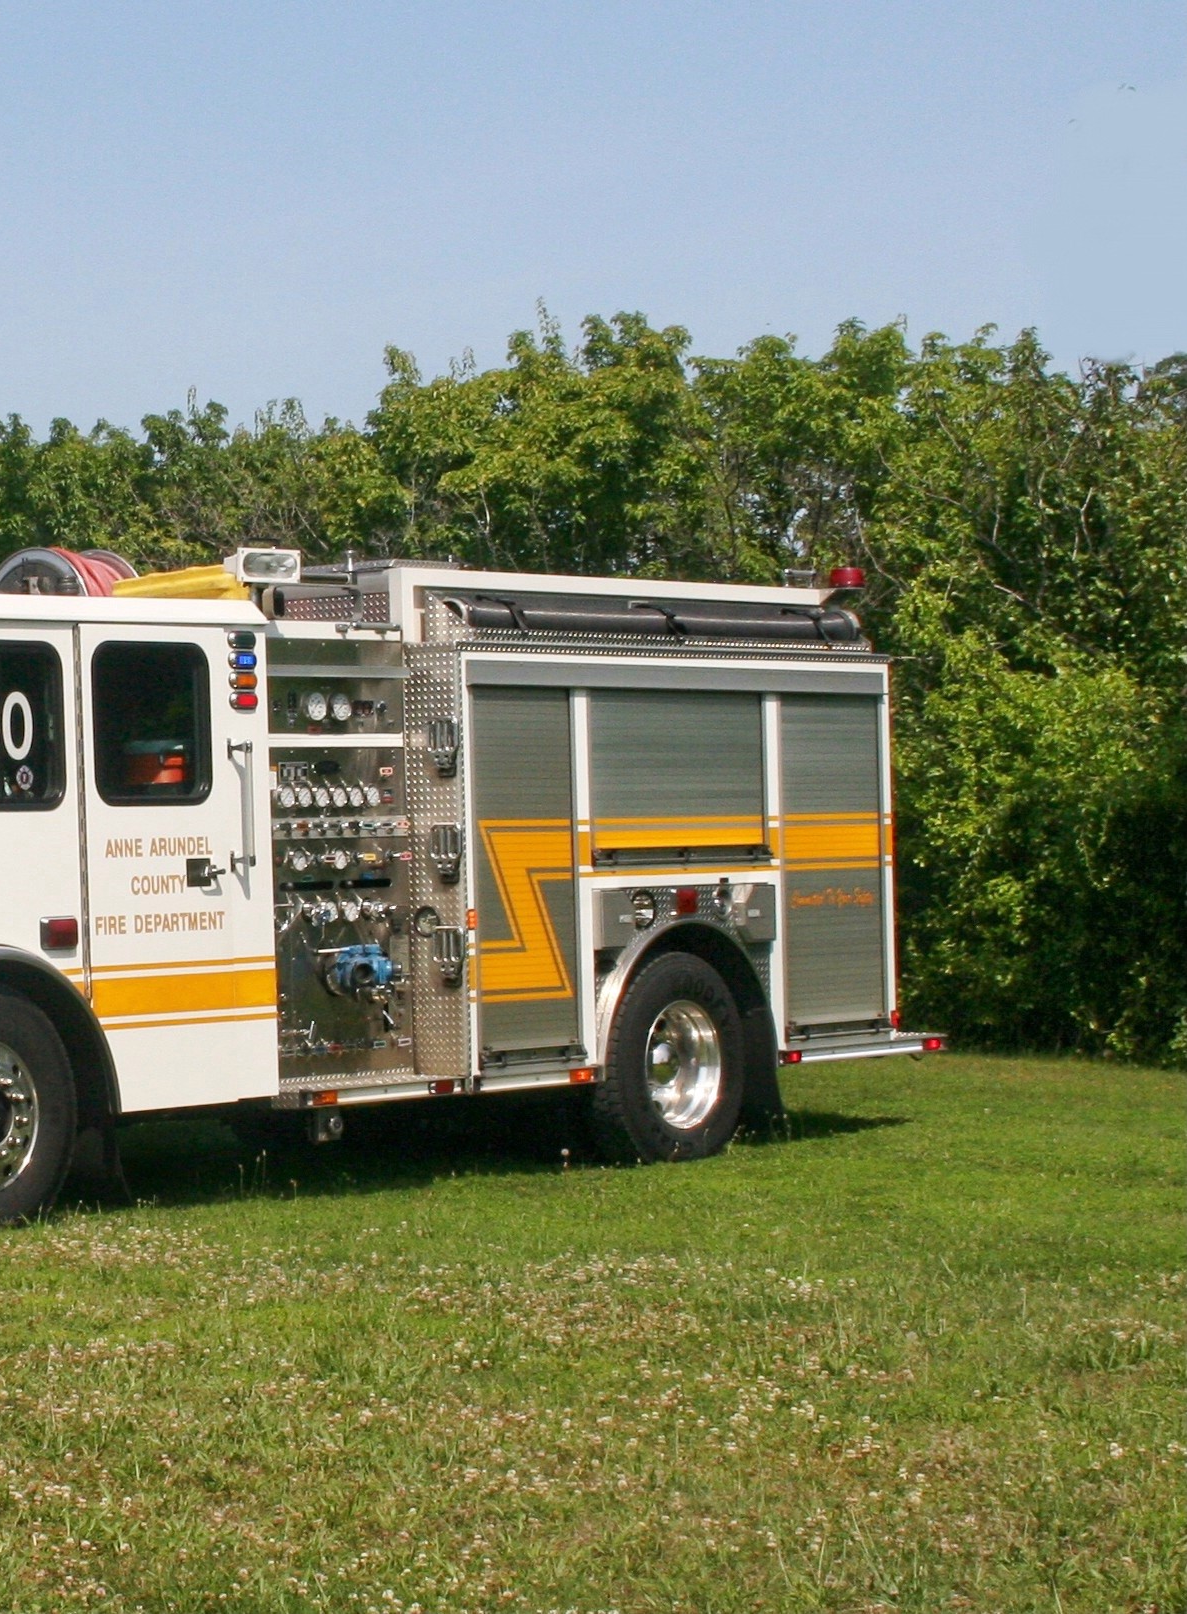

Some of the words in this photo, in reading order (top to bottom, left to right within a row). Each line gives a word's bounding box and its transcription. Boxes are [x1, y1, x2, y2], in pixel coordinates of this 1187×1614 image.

[105, 838, 143, 858] ANNE
[150, 836, 213, 857] ARUNDEL
[131, 874, 186, 895] COUNTY
[95, 915, 127, 936] FIRE
[134, 911, 225, 934] DEPARTMENT
